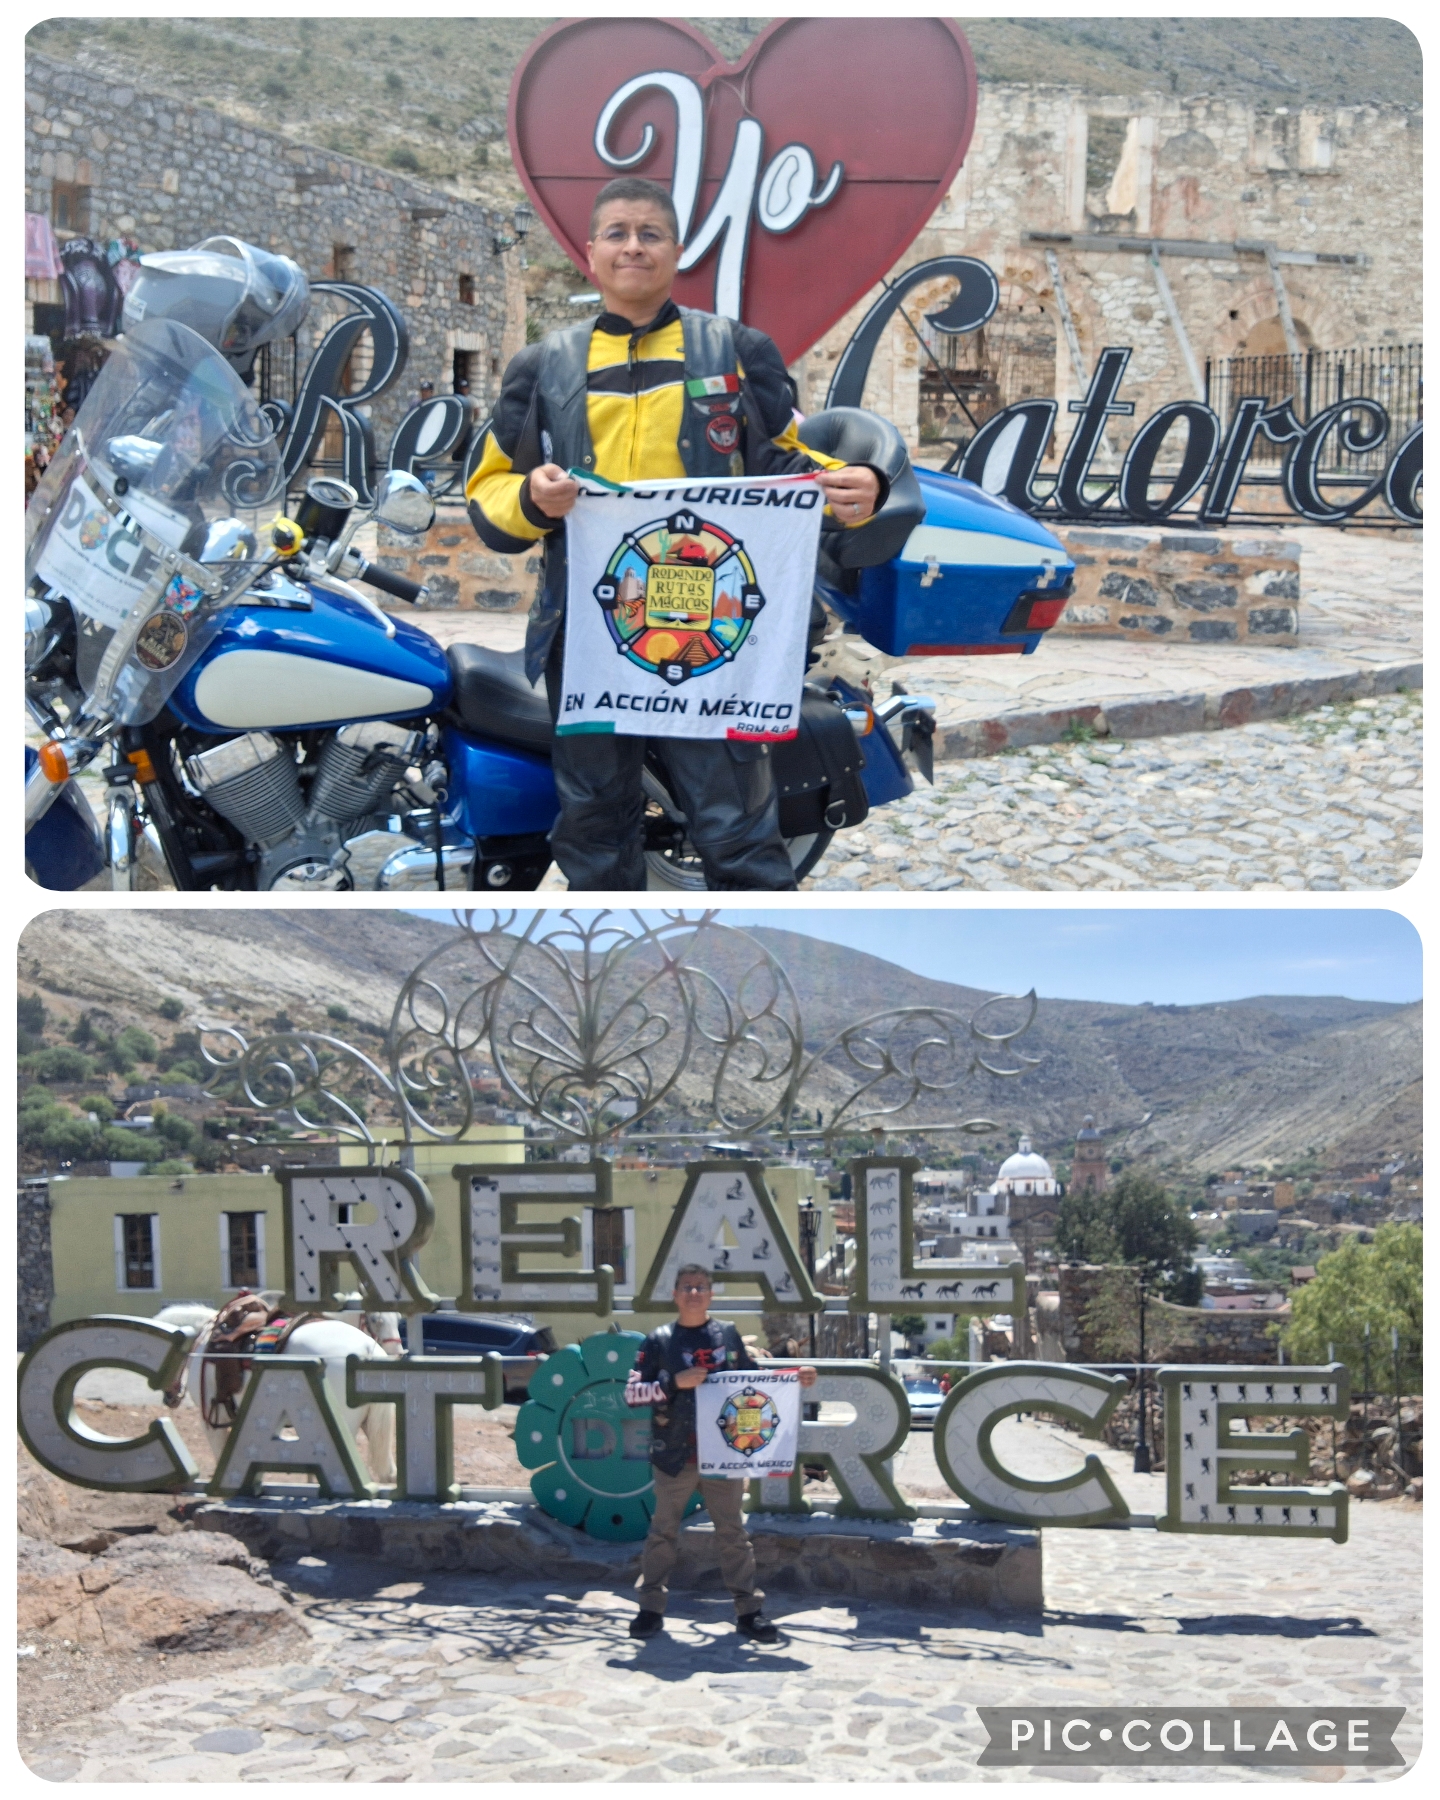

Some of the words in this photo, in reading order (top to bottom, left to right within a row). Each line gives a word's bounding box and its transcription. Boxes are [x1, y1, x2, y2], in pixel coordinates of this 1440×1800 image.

[592, 68, 845, 321] Yo
[675, 515, 695, 530] N
[745, 594, 760, 608] E
[666, 666, 683, 679] S
[565, 693, 585, 712] EN
[594, 689, 688, 714] ACCIÓN
[699, 694, 793, 720] MÉXICO
[274, 1156, 1026, 1317] REAL
[571, 1418, 653, 1460] DE
[701, 1462, 715, 1470] EN
